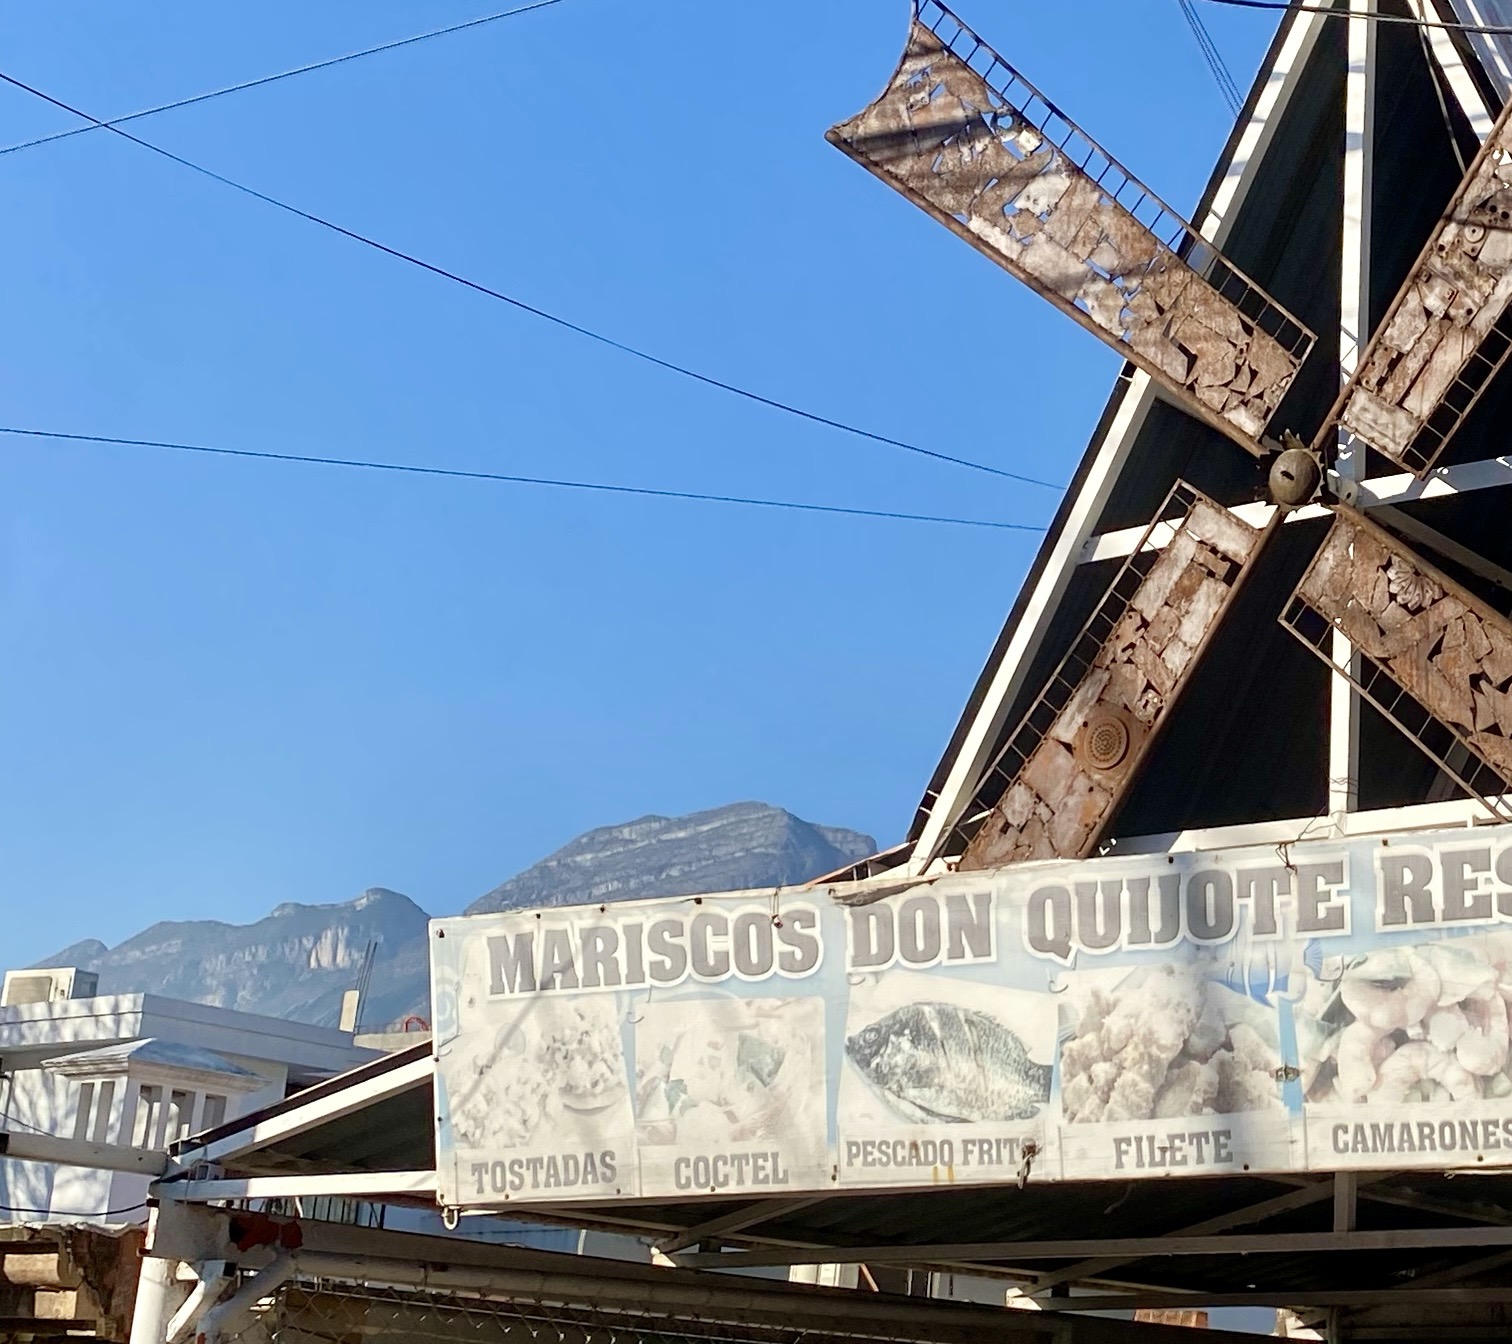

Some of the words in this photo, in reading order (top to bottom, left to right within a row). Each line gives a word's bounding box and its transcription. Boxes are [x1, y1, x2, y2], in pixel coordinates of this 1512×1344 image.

[486, 909, 822, 996] MARISCOS
[847, 893, 994, 968] DON
[1026, 859, 1347, 960] QUIJOTE
[846, 1138, 954, 1168] PESCADO
[1114, 1129, 1233, 1169] FILETE
[471, 1151, 617, 1194] TOSTADAS
[674, 1152, 789, 1190] COCTEL
